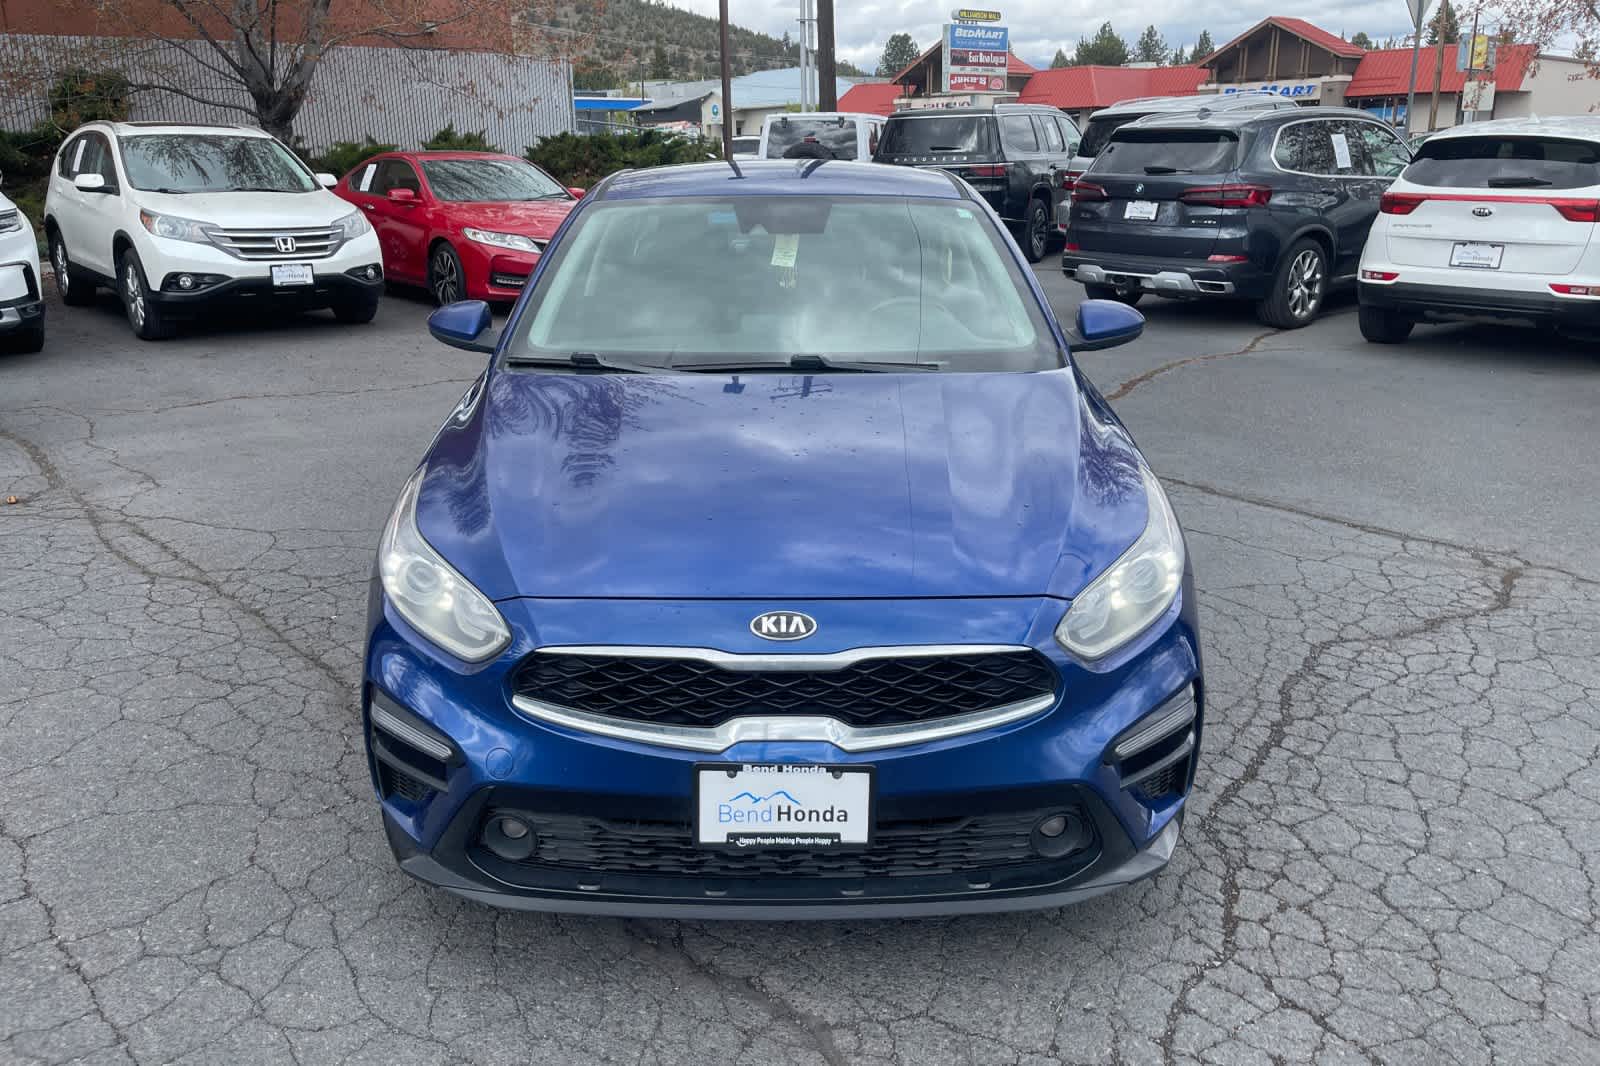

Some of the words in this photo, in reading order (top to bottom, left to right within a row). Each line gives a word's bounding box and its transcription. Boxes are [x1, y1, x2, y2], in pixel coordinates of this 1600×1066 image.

[761, 616, 806, 633] KIA
[743, 764, 778, 773] Bend
[783, 765, 827, 774] Honda
[739, 837, 757, 846] Happy
[757, 837, 775, 845] People
[776, 837, 796, 846] Making
[796, 837, 813, 845] People
[814, 837, 832, 846] Happy
